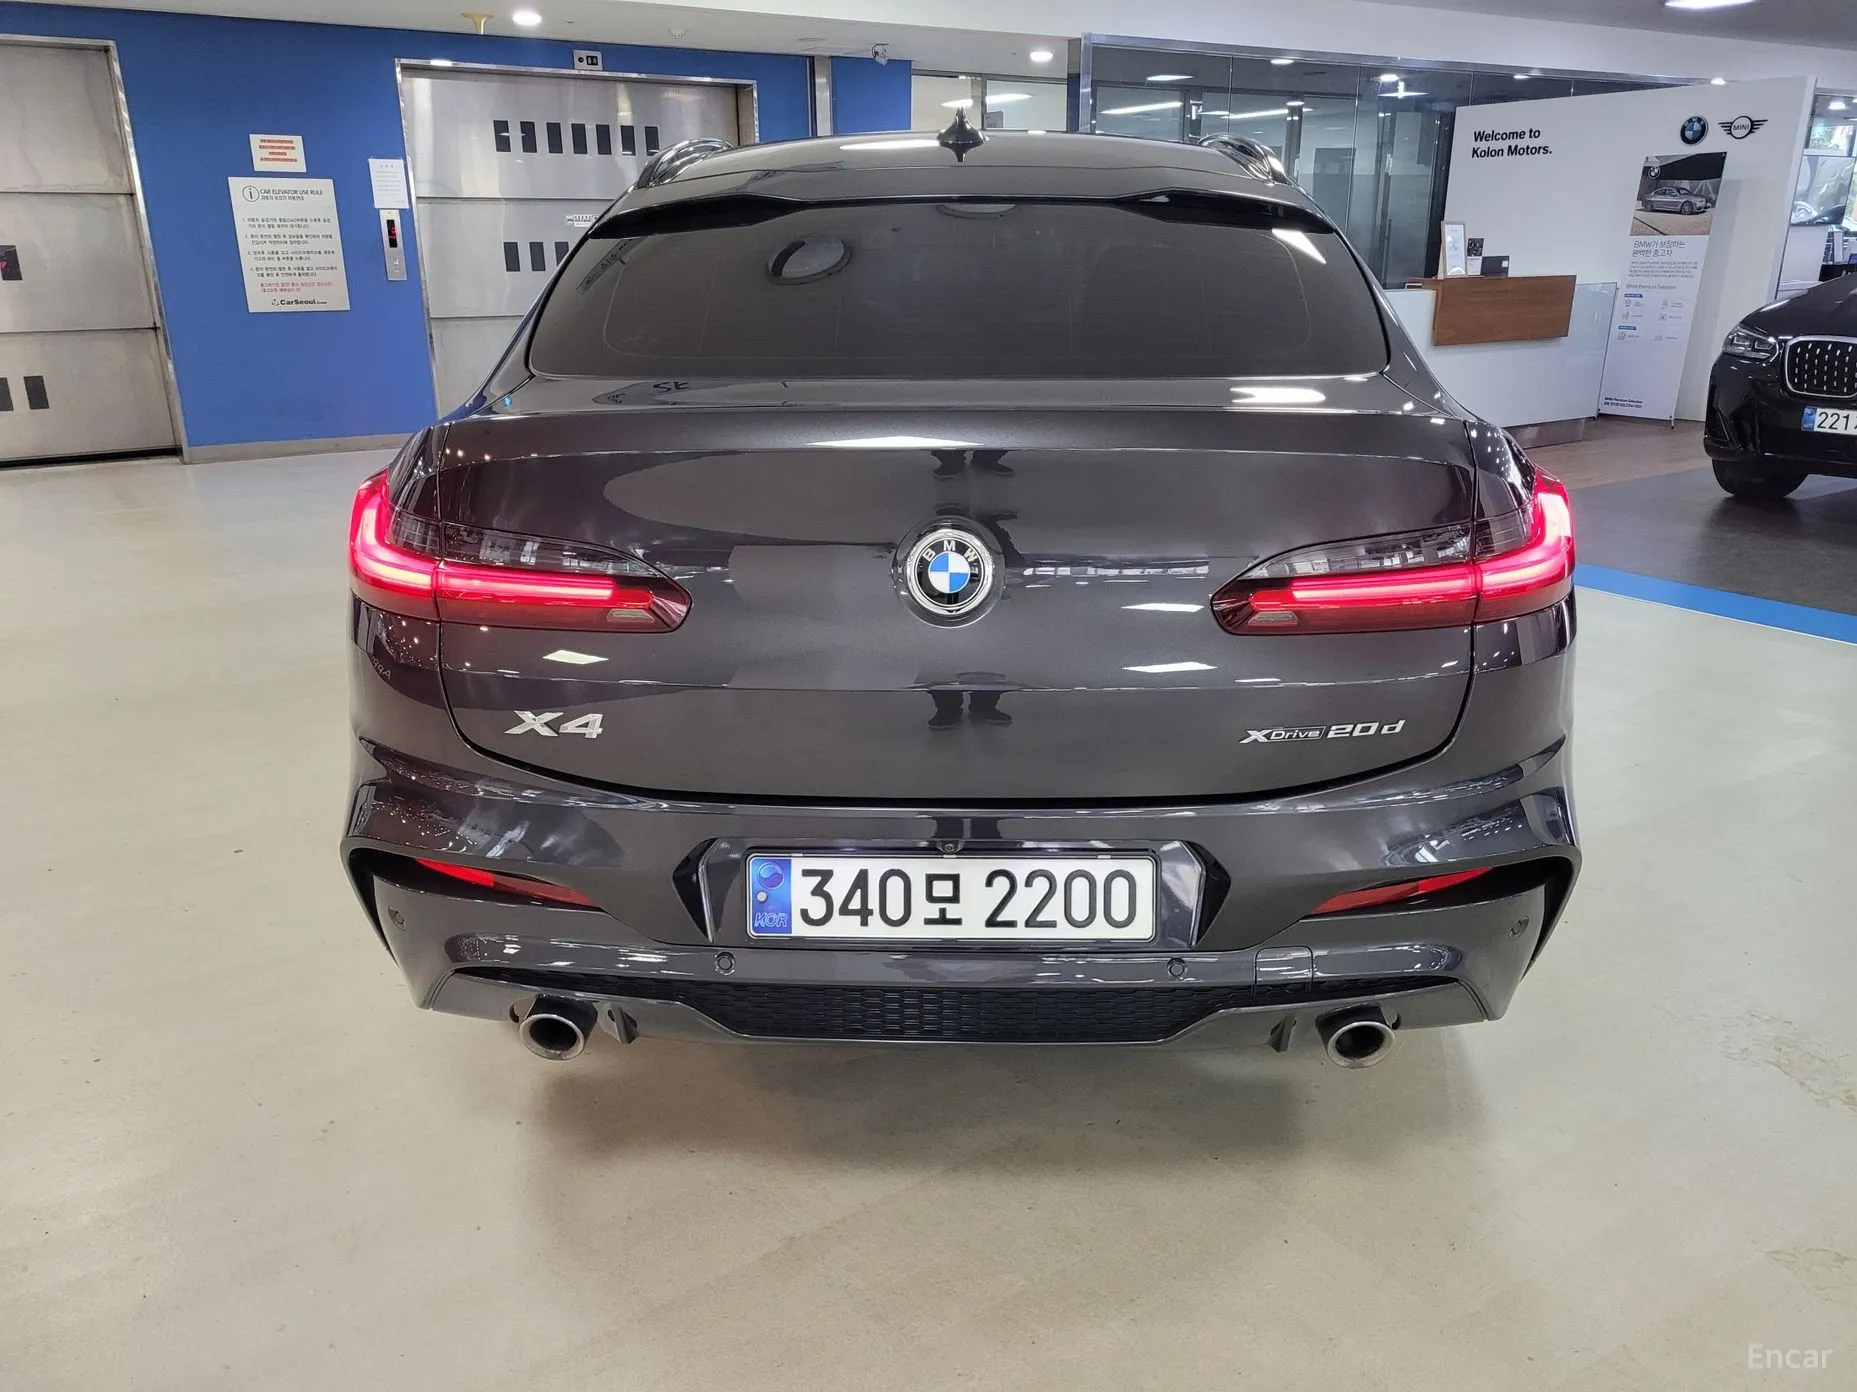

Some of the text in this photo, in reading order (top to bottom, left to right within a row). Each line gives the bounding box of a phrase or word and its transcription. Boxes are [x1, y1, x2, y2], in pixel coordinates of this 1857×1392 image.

[1474, 128, 1541, 142] Welcome to
[1472, 144, 1553, 158] Kolon Motors.
[1633, 240, 1659, 249] BMW가
[1817, 411, 1857, 431] 221
[922, 539, 978, 563] BMW
[503, 710, 604, 739] X4
[799, 868, 1137, 928] 340모 2200
[753, 912, 788, 928] KOR
